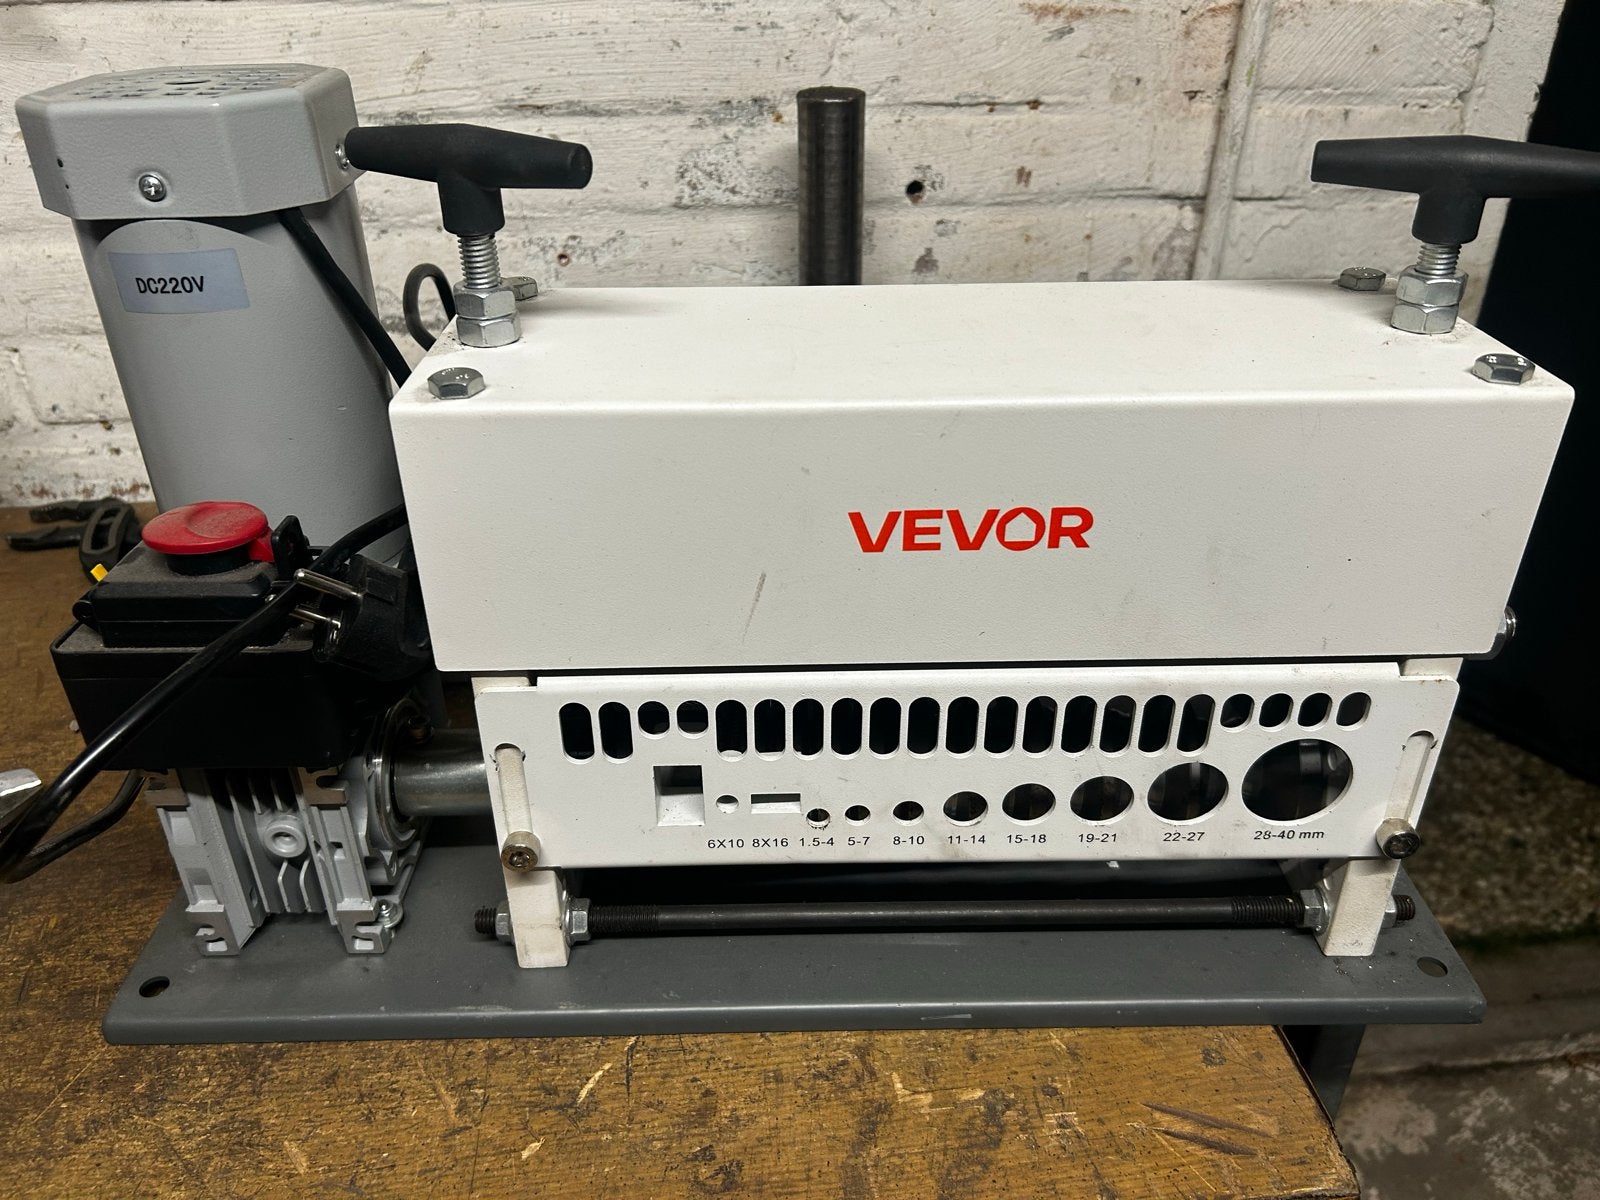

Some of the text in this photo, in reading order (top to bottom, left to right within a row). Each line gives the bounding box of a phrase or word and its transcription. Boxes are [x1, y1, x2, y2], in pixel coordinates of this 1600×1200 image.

[135, 275, 204, 295] DC220V
[848, 506, 1094, 553] VEVOR
[707, 829, 1325, 849] 6X10 8X16 1.5-4 5-7 8-10 11-14 15-18 19-21 22-27 28-40 mm
